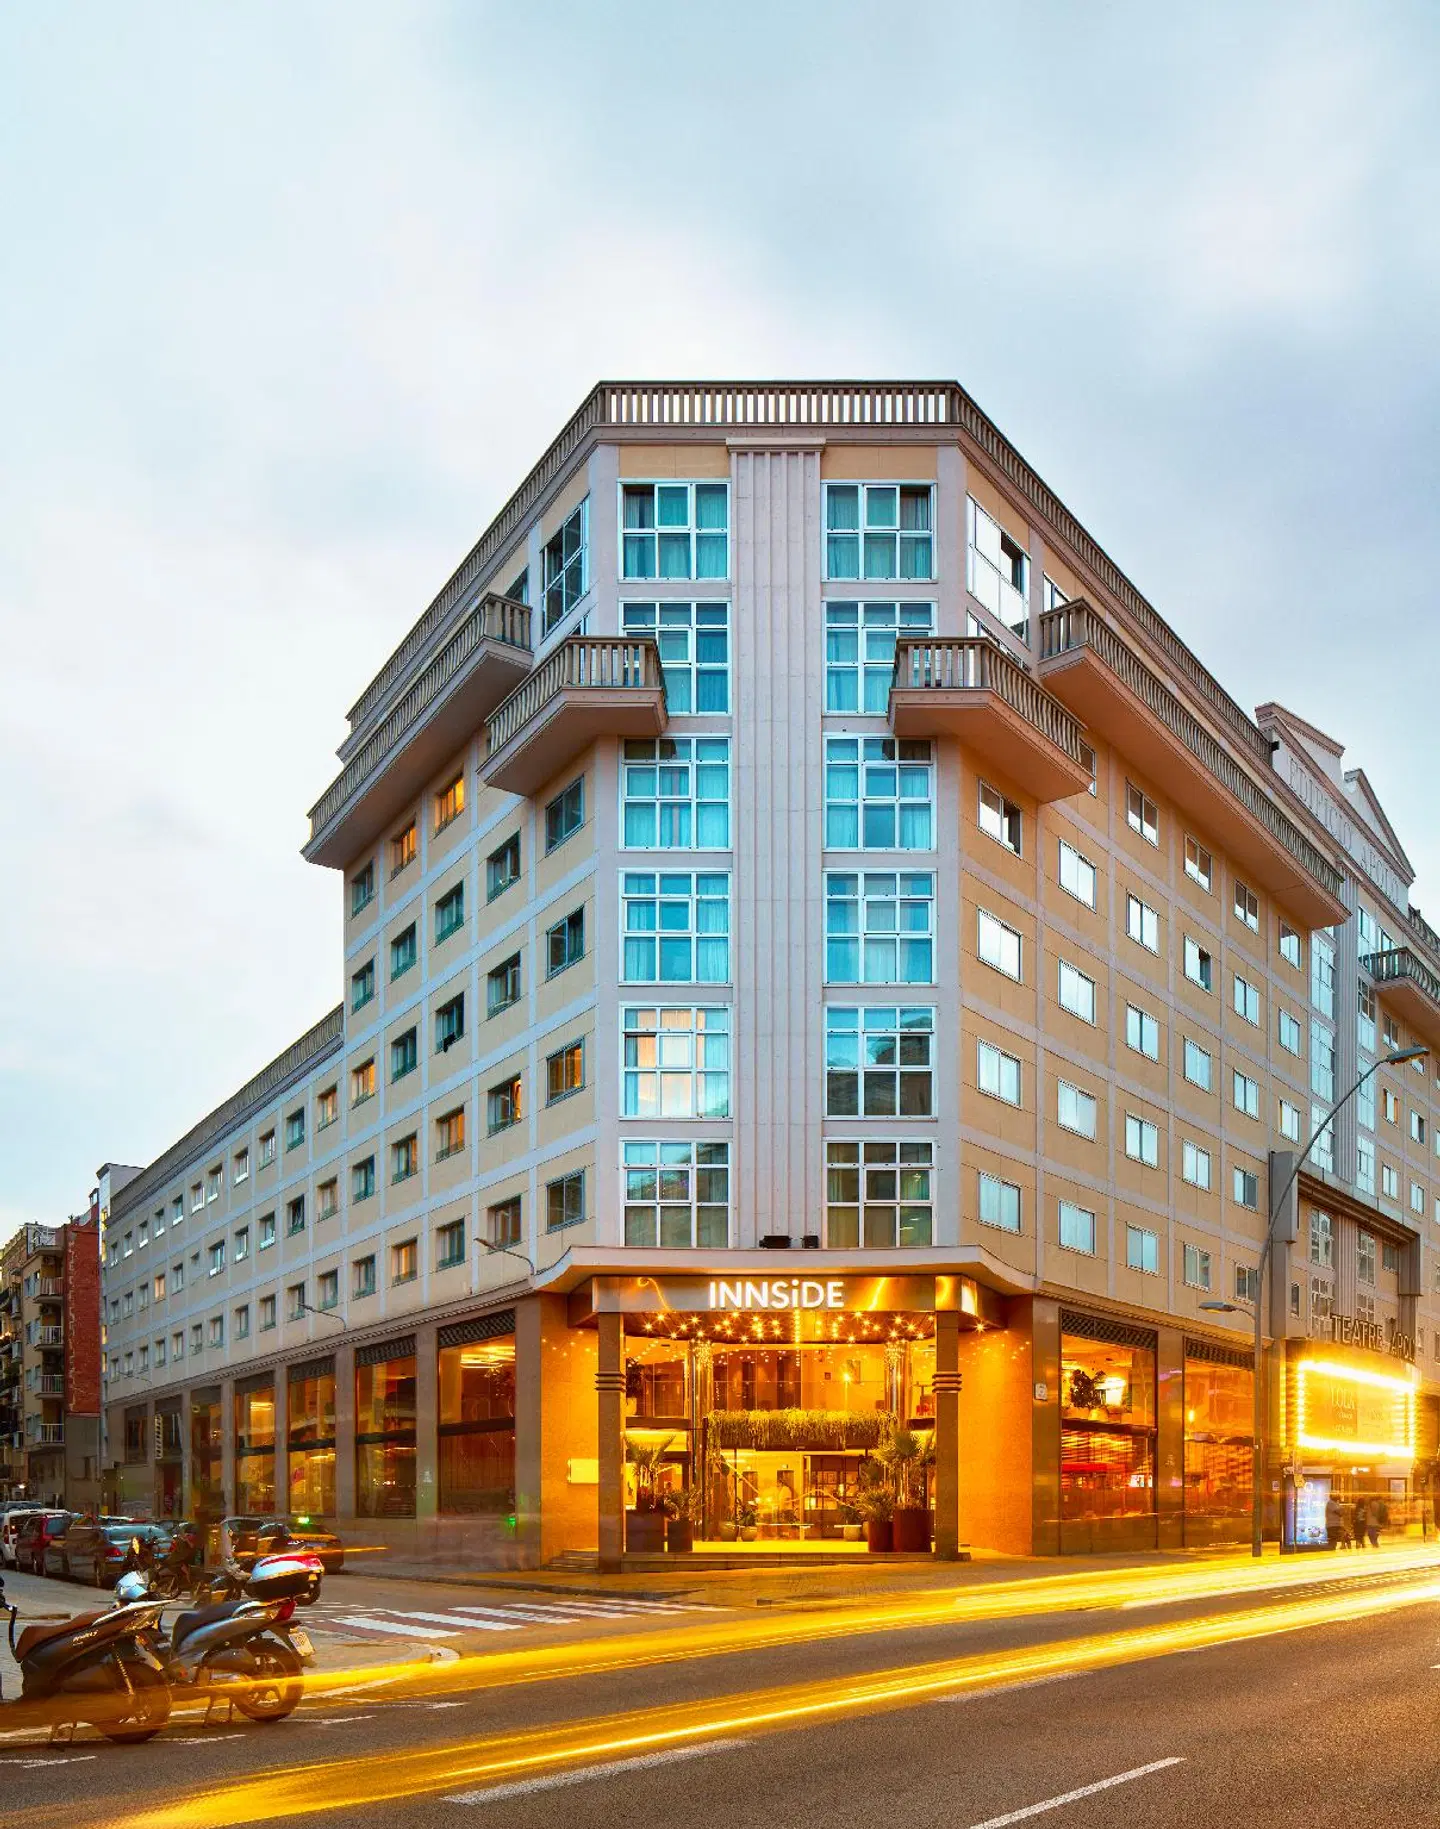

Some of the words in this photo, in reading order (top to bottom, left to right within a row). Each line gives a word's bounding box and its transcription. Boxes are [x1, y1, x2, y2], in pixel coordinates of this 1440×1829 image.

[1288, 756, 1352, 852] EDIFICIO
[1360, 845, 1400, 905] APOLO
[1331, 1313, 1382, 1352] TEATRE
